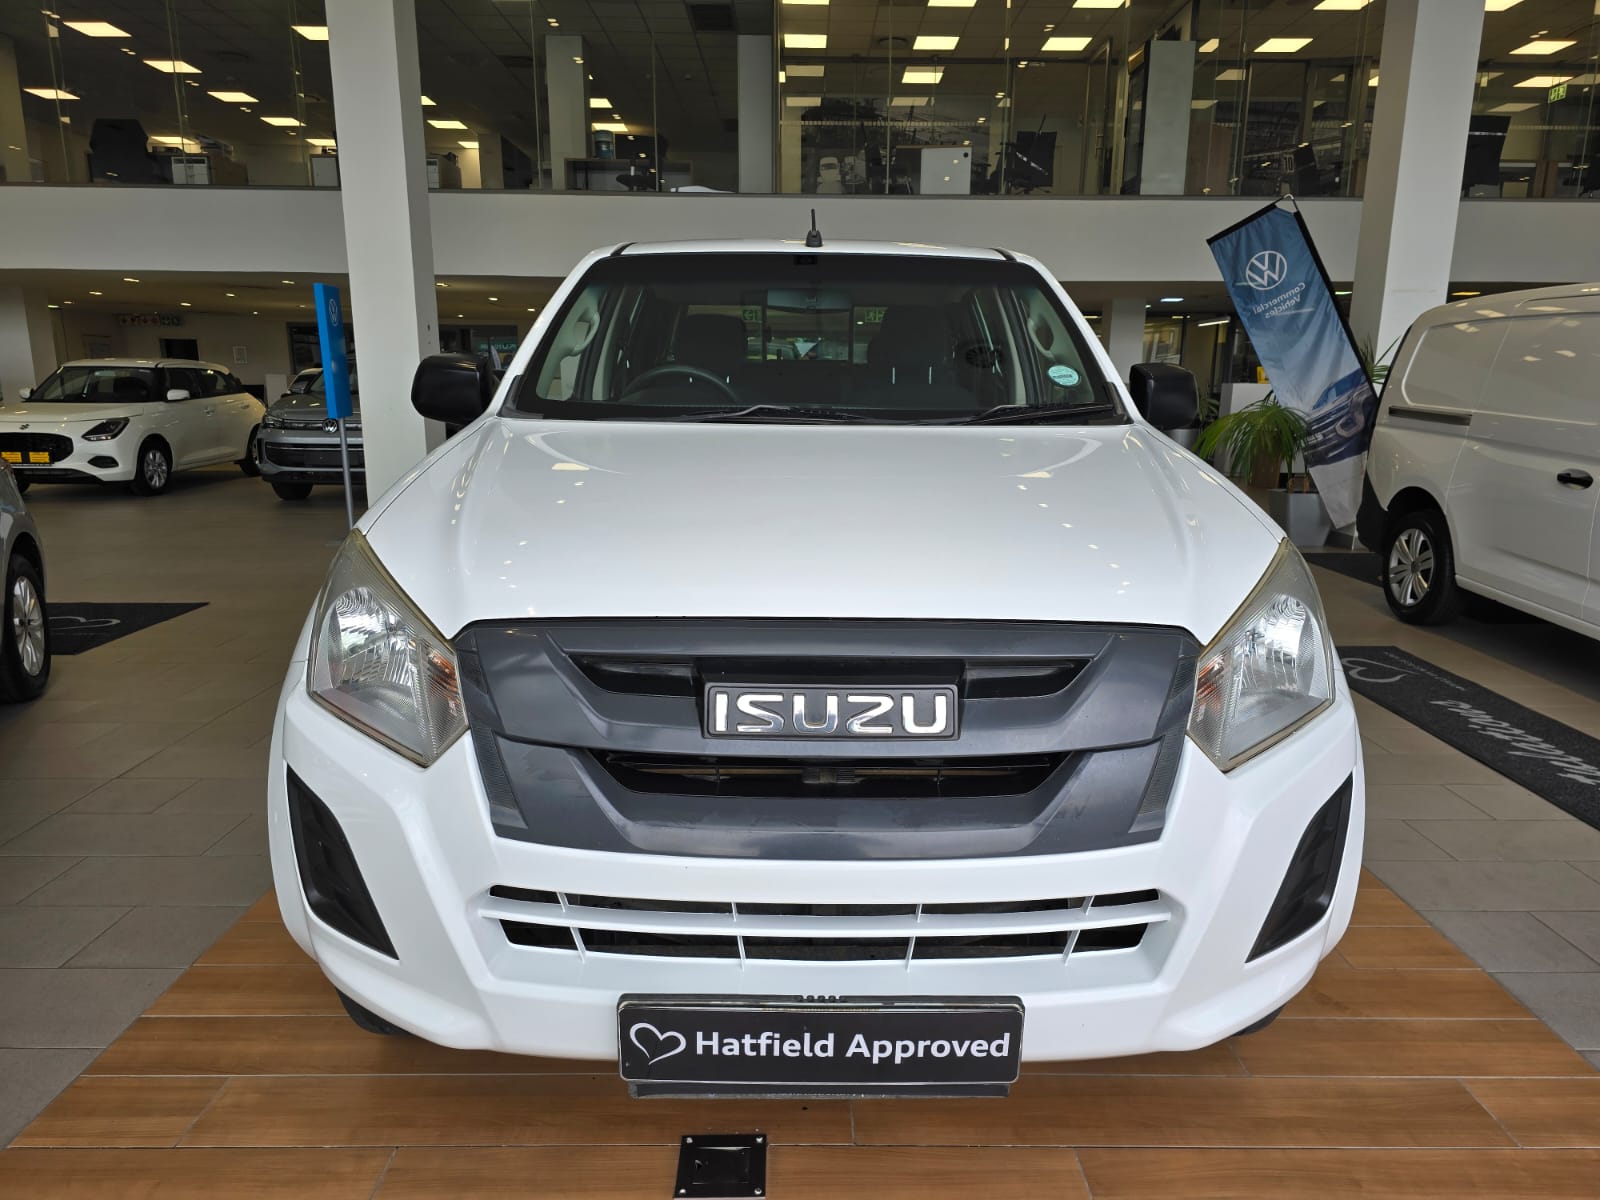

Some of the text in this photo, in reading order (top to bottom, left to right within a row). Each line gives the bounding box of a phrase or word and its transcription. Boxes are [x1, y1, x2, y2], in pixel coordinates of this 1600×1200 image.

[716, 694, 947, 733] ISUZU
[696, 1031, 1010, 1064] Hatfield Approved
